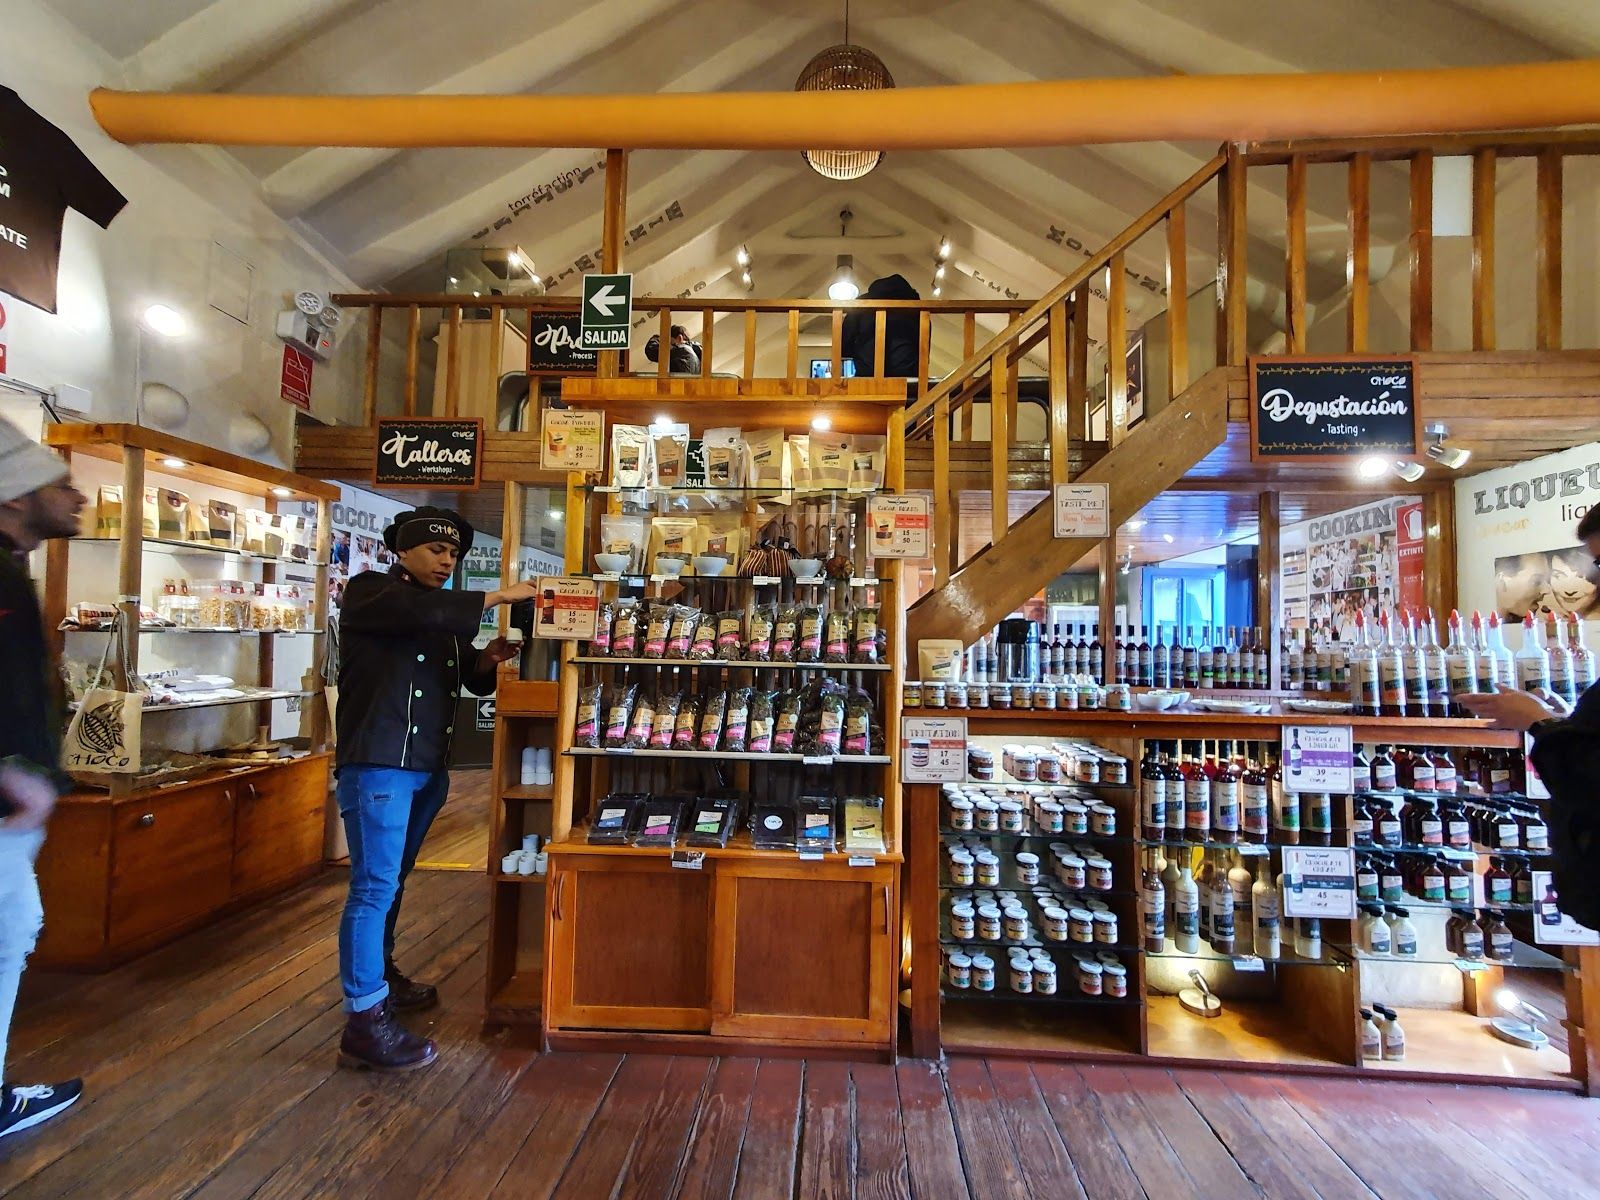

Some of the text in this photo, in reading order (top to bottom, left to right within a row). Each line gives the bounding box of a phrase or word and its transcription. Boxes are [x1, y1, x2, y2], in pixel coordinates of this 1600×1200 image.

[534, 323, 582, 354] Pro
[584, 330, 627, 344] SALIDA
[572, 351, 593, 360] Process
[1260, 388, 1408, 425] Degustación
[1326, 423, 1359, 437] Tasting
[381, 430, 472, 468] Talleres
[421, 465, 453, 475] Workshops
[939, 758, 950, 766] 45
